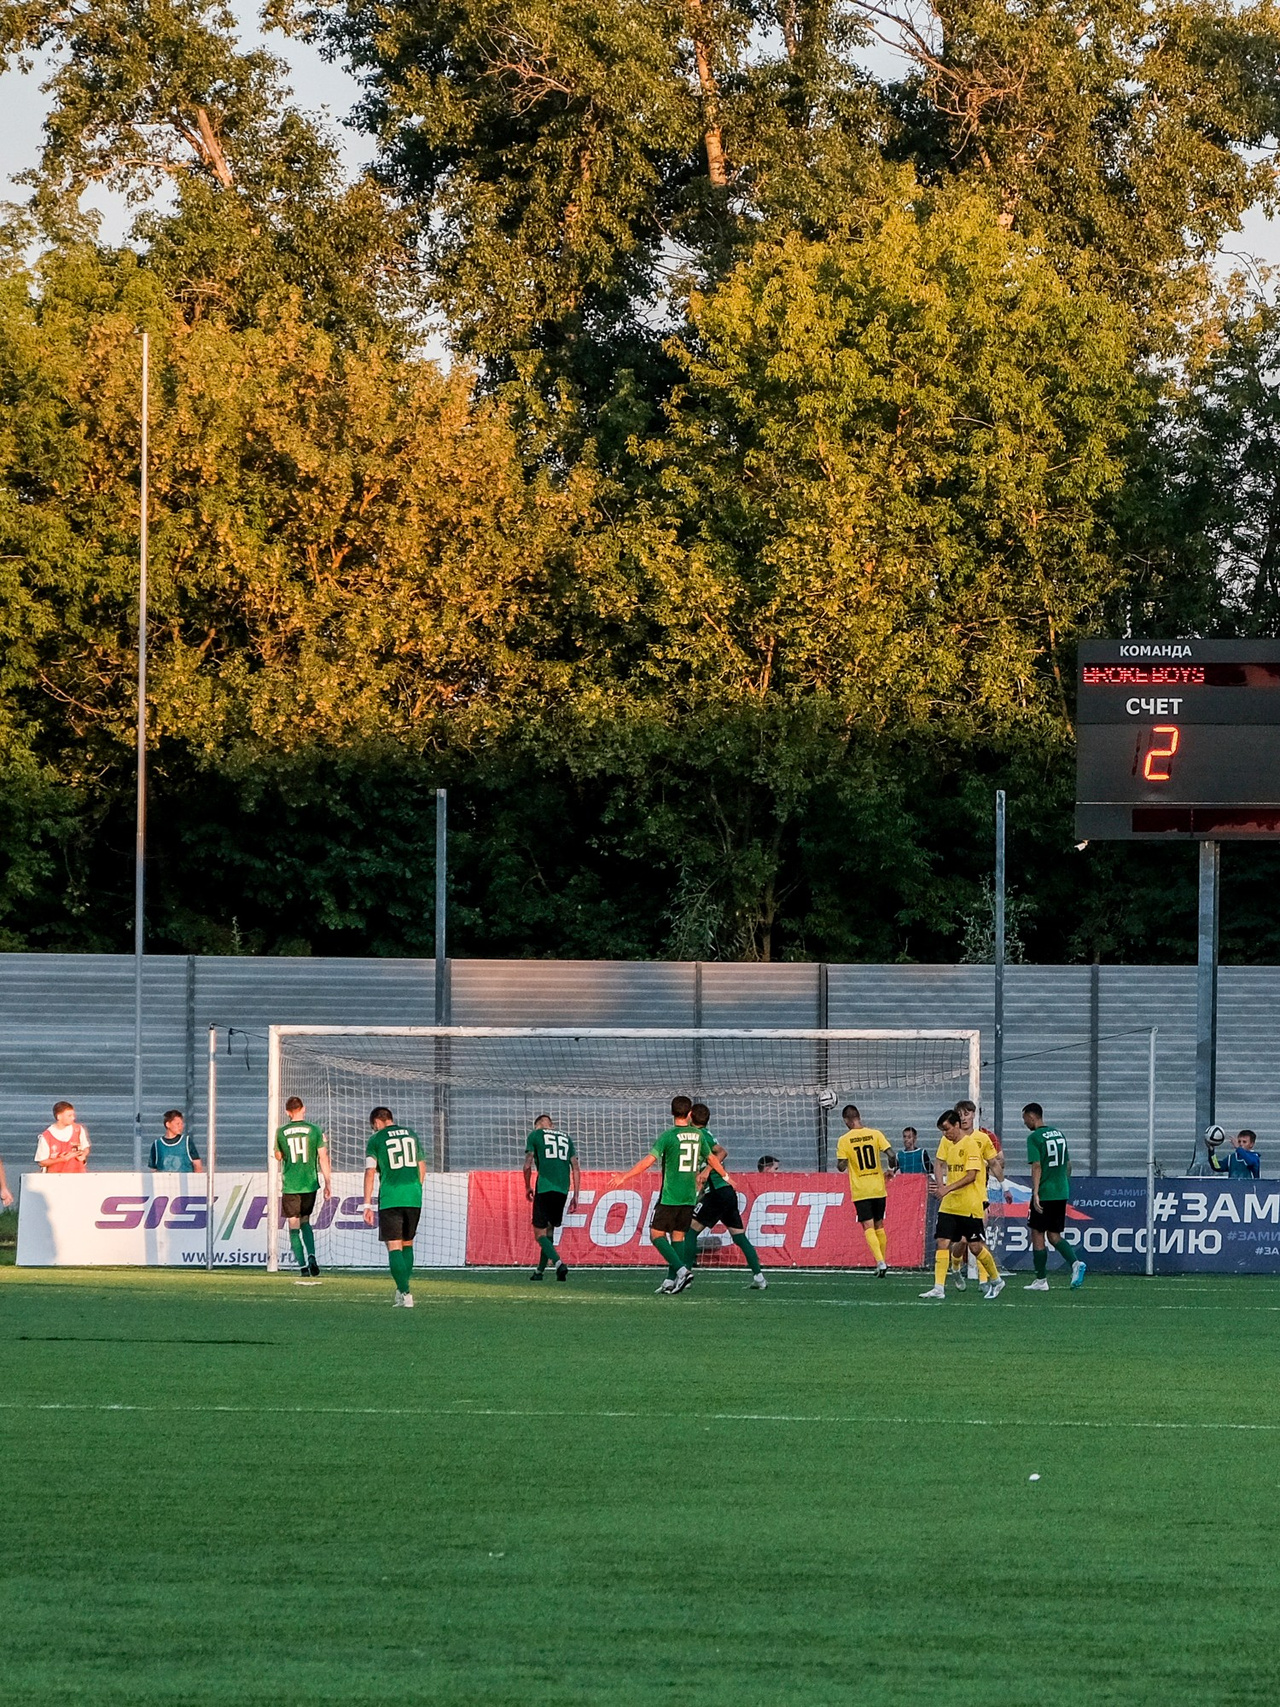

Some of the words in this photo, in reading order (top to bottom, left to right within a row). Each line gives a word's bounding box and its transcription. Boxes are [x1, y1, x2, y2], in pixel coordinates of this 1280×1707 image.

[1119, 645, 1192, 658] КОМАНДА
[1125, 697, 1184, 715] СЧЕТ
[1144, 725, 1179, 781] 2
[287, 1136, 308, 1164] 14
[385, 1137, 418, 1170] 20
[543, 1133, 570, 1161] 55
[678, 1142, 700, 1172] 21
[853, 1144, 877, 1171] 10
[1045, 1138, 1066, 1168] 97
[95, 1196, 218, 1230] SIS
[1072, 1199, 1137, 1208] #ЗАРОССИЮ
